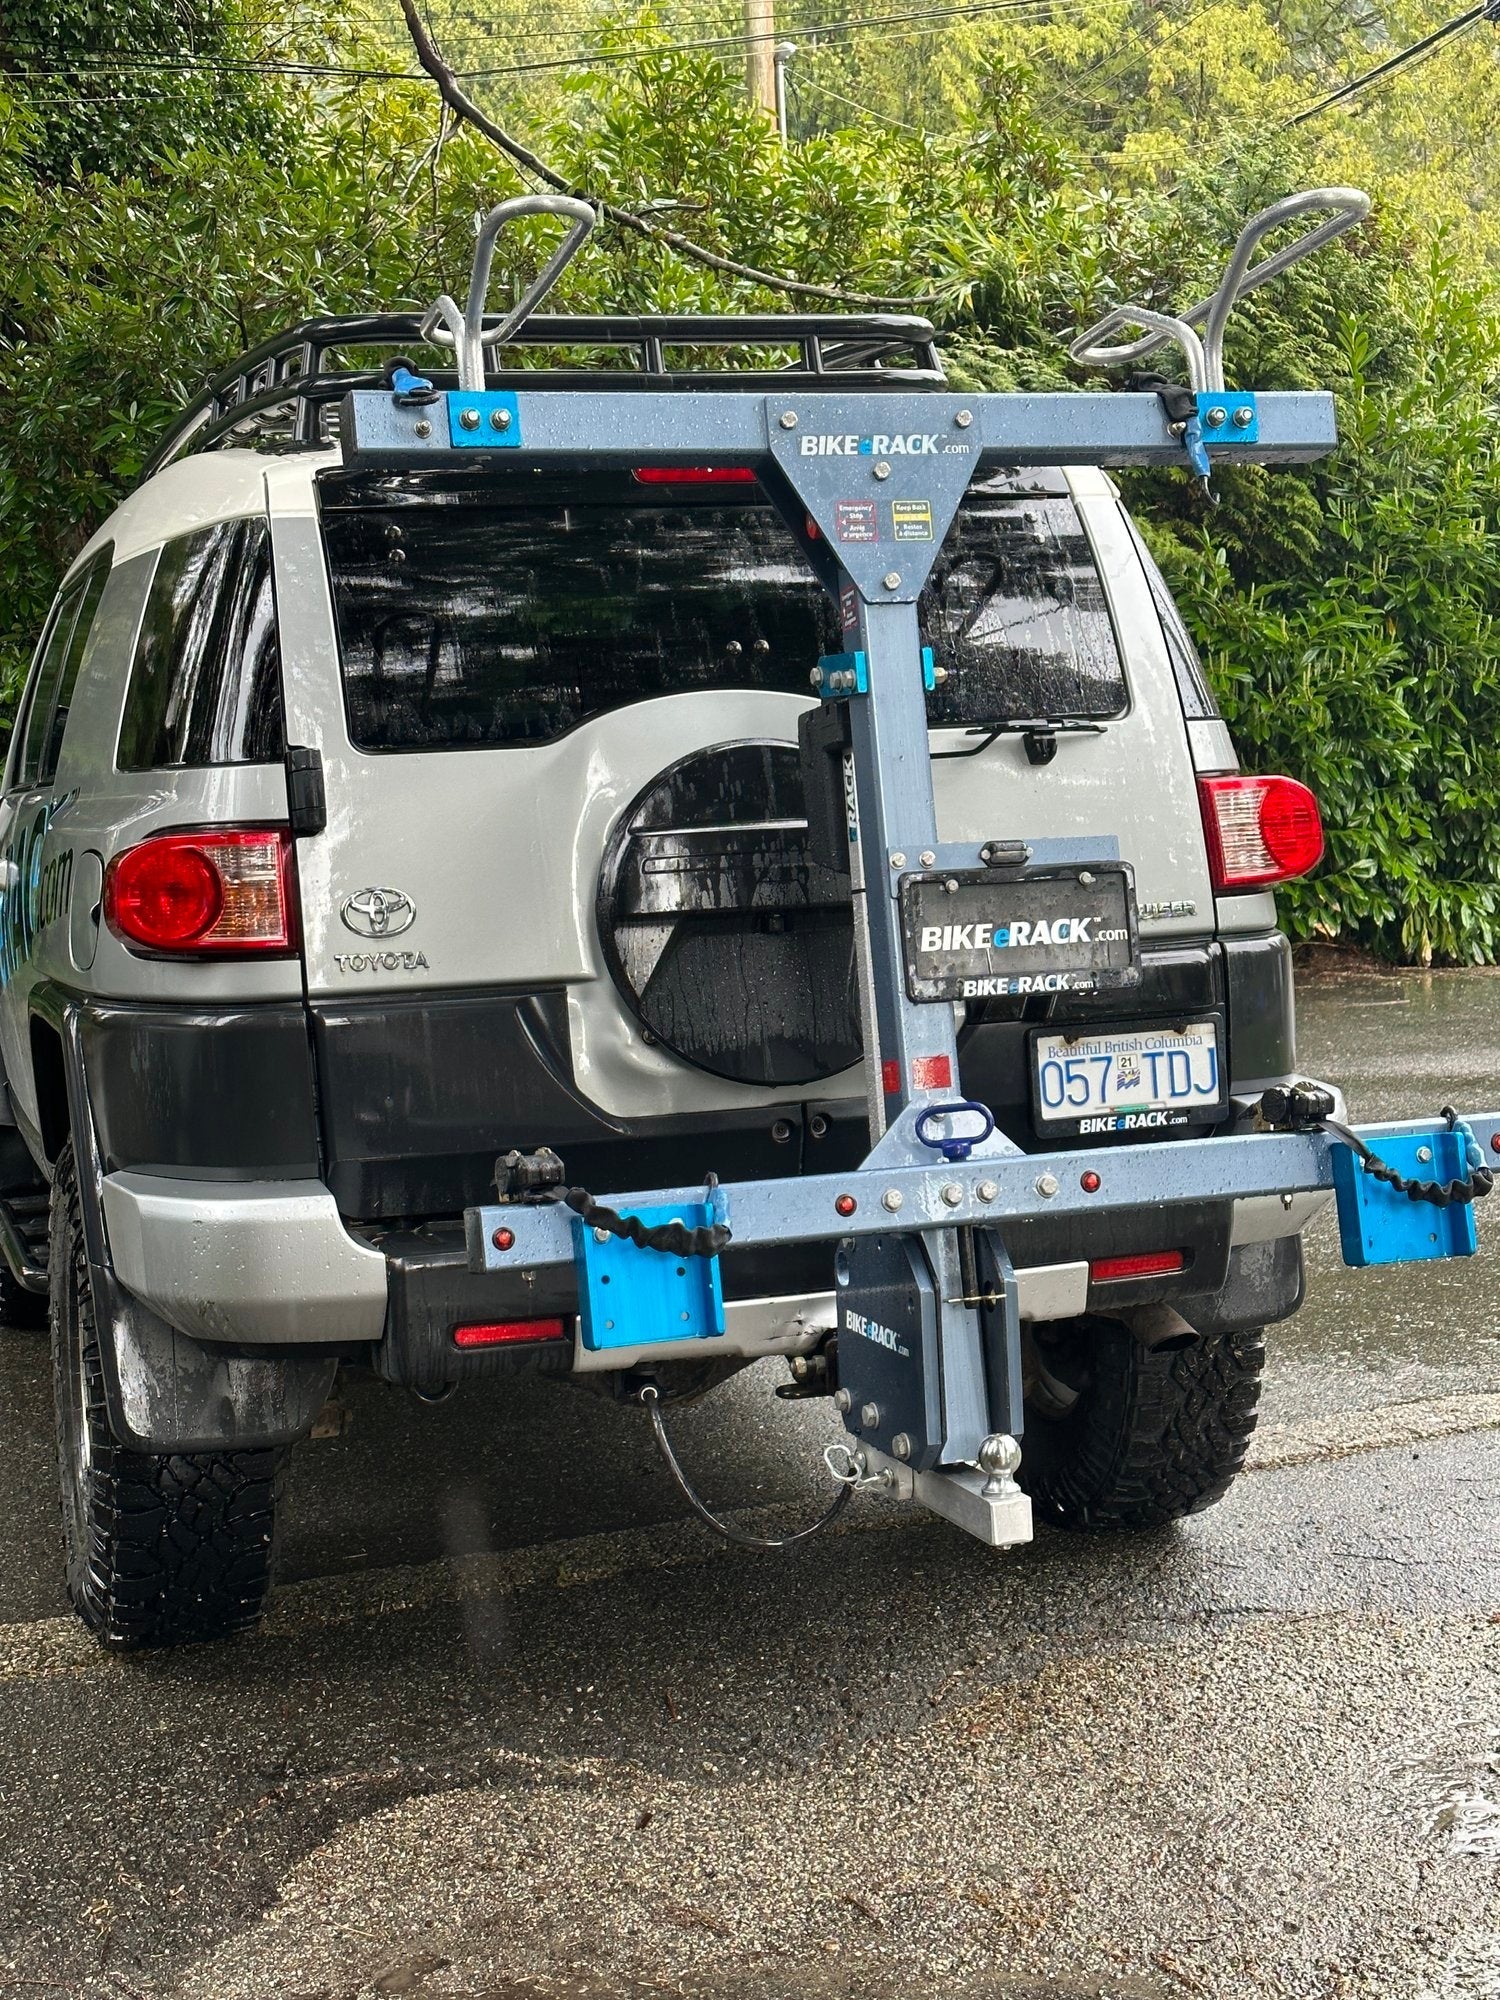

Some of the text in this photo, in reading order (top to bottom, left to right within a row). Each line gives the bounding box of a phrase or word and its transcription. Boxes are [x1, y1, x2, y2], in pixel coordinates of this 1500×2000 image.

[334, 951, 430, 972] TOYOTA
[1047, 1034, 1203, 1059] Beautiful British Columbia
[1120, 1057, 1133, 1068] 21
[1041, 1047, 1217, 1108] 057 TDJ
